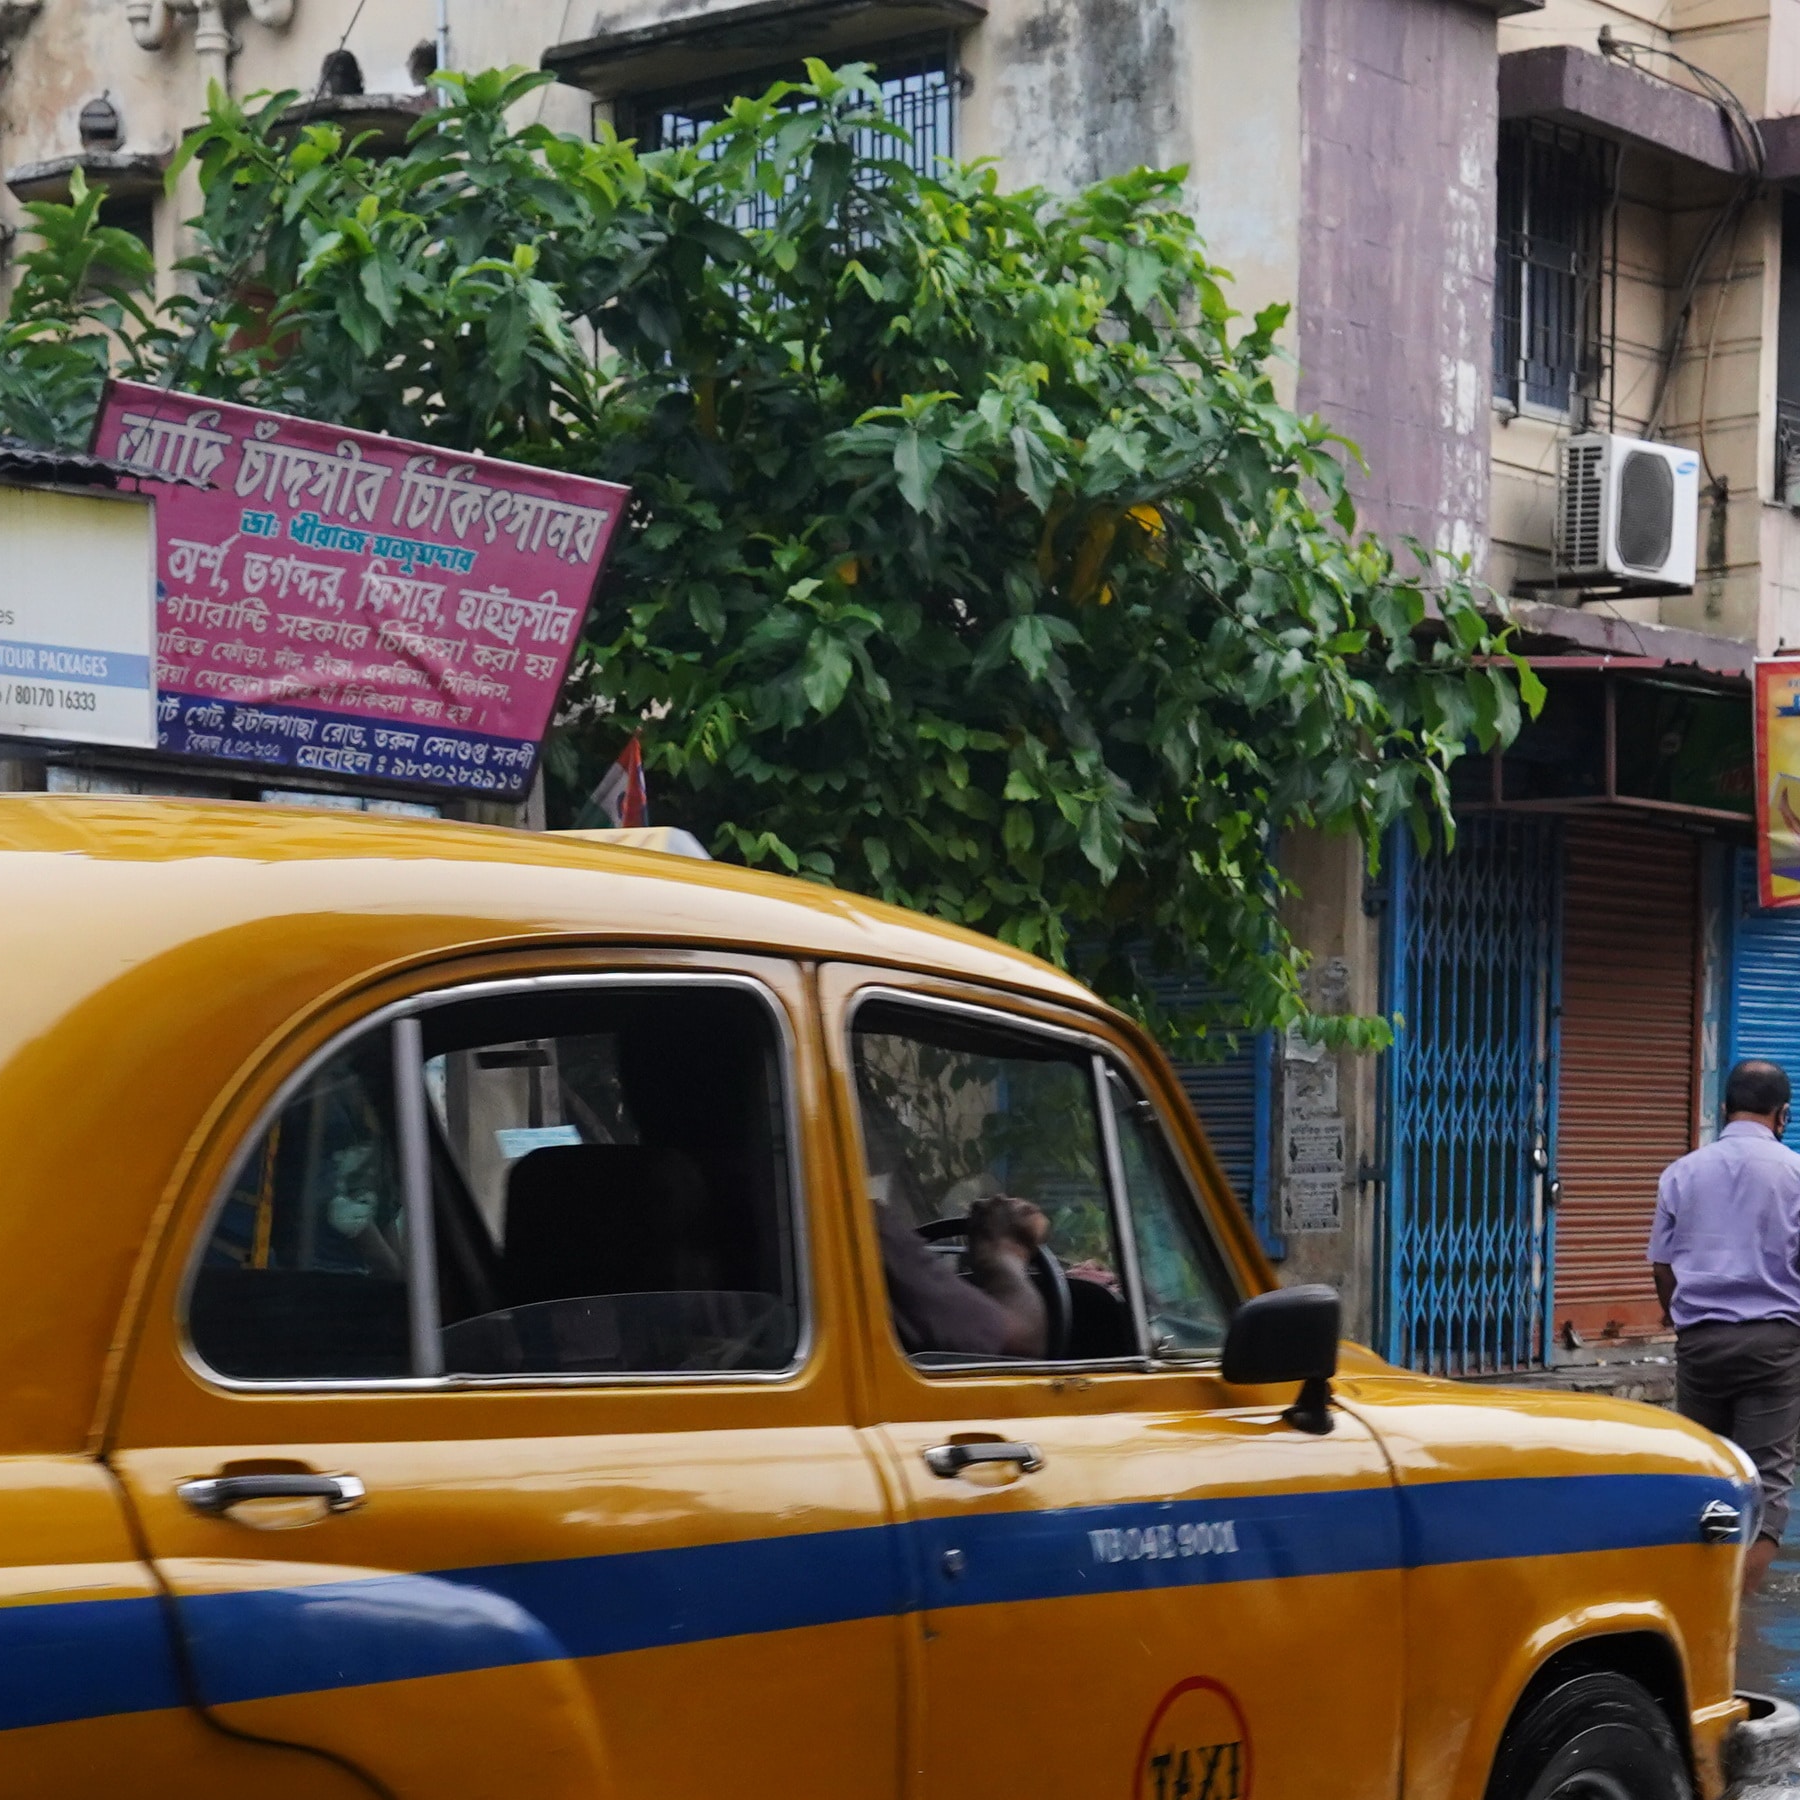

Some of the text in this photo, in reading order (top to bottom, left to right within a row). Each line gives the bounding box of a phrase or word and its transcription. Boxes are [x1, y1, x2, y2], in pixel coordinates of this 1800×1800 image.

[234, 420, 393, 523] চাঁদসীর
[392, 454, 608, 565] চিকিৎসালয়
[38, 649, 108, 677] PACKAGES
[276, 613, 371, 649] সহকারে
[472, 644, 519, 673] করা
[524, 653, 558, 681] হয়
[15, 685, 55, 708] 80170
[58, 689, 97, 712] 16333
